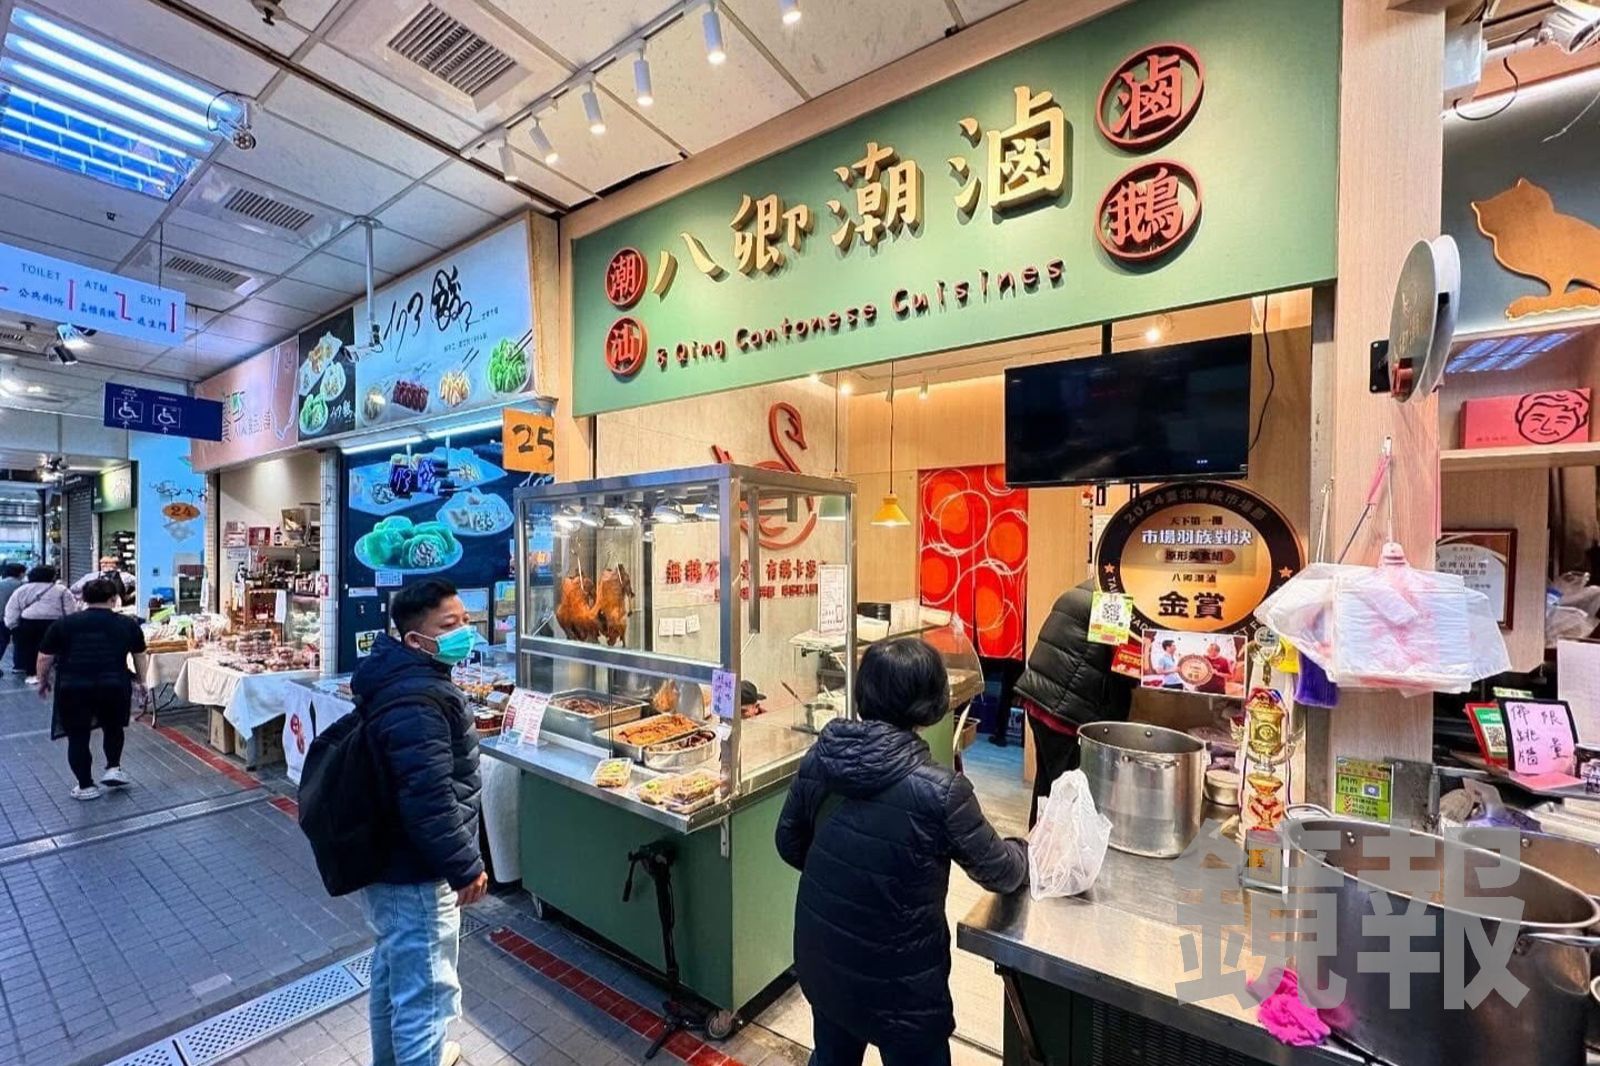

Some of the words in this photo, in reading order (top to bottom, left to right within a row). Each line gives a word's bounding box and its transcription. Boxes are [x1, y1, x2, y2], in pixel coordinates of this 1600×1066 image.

[652, 86, 1068, 298] 八卿潮滷
[20, 262, 61, 282] TOILET
[84, 279, 109, 294] ATM
[140, 293, 162, 307] EXIT
[736, 303, 877, 351] Cantonese
[892, 257, 1065, 316] Cuisines
[512, 423, 555, 463] 25
[1141, 529, 1253, 546] 市場羽族對決
[1158, 590, 1226, 621] 金賞
